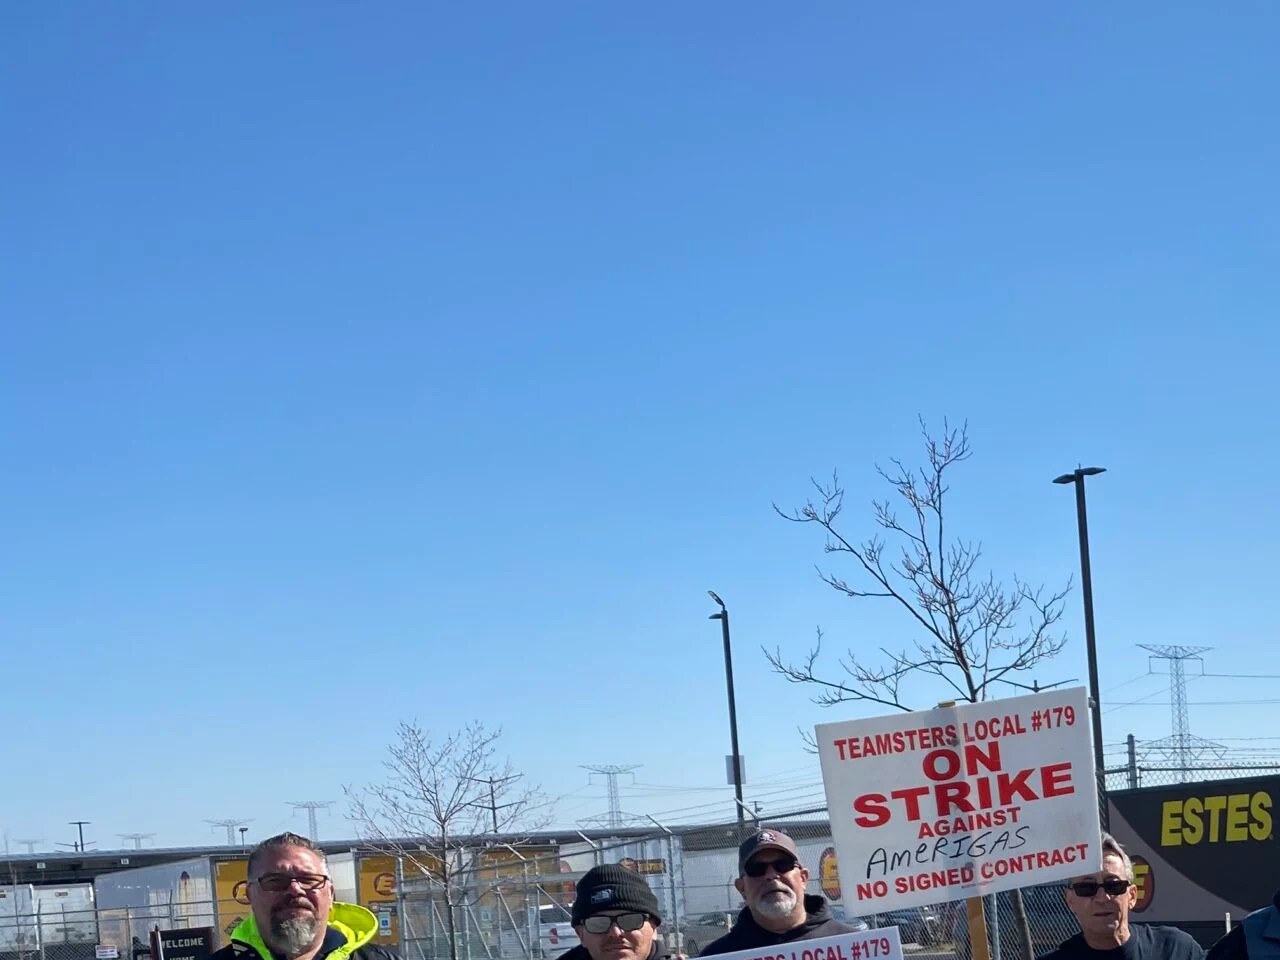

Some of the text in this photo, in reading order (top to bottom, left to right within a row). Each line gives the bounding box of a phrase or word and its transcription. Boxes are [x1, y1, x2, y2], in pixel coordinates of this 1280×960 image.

[834, 705, 1076, 760] TEAMSTERS LOCAL #179
[922, 740, 1002, 782] ON
[853, 762, 1075, 828] STRIKE
[1161, 791, 1273, 846] ESTES
[917, 806, 1021, 840] AGAINST
[856, 843, 1089, 901] NO SIGNED CONTRACT
[850, 937, 891, 960] #179
